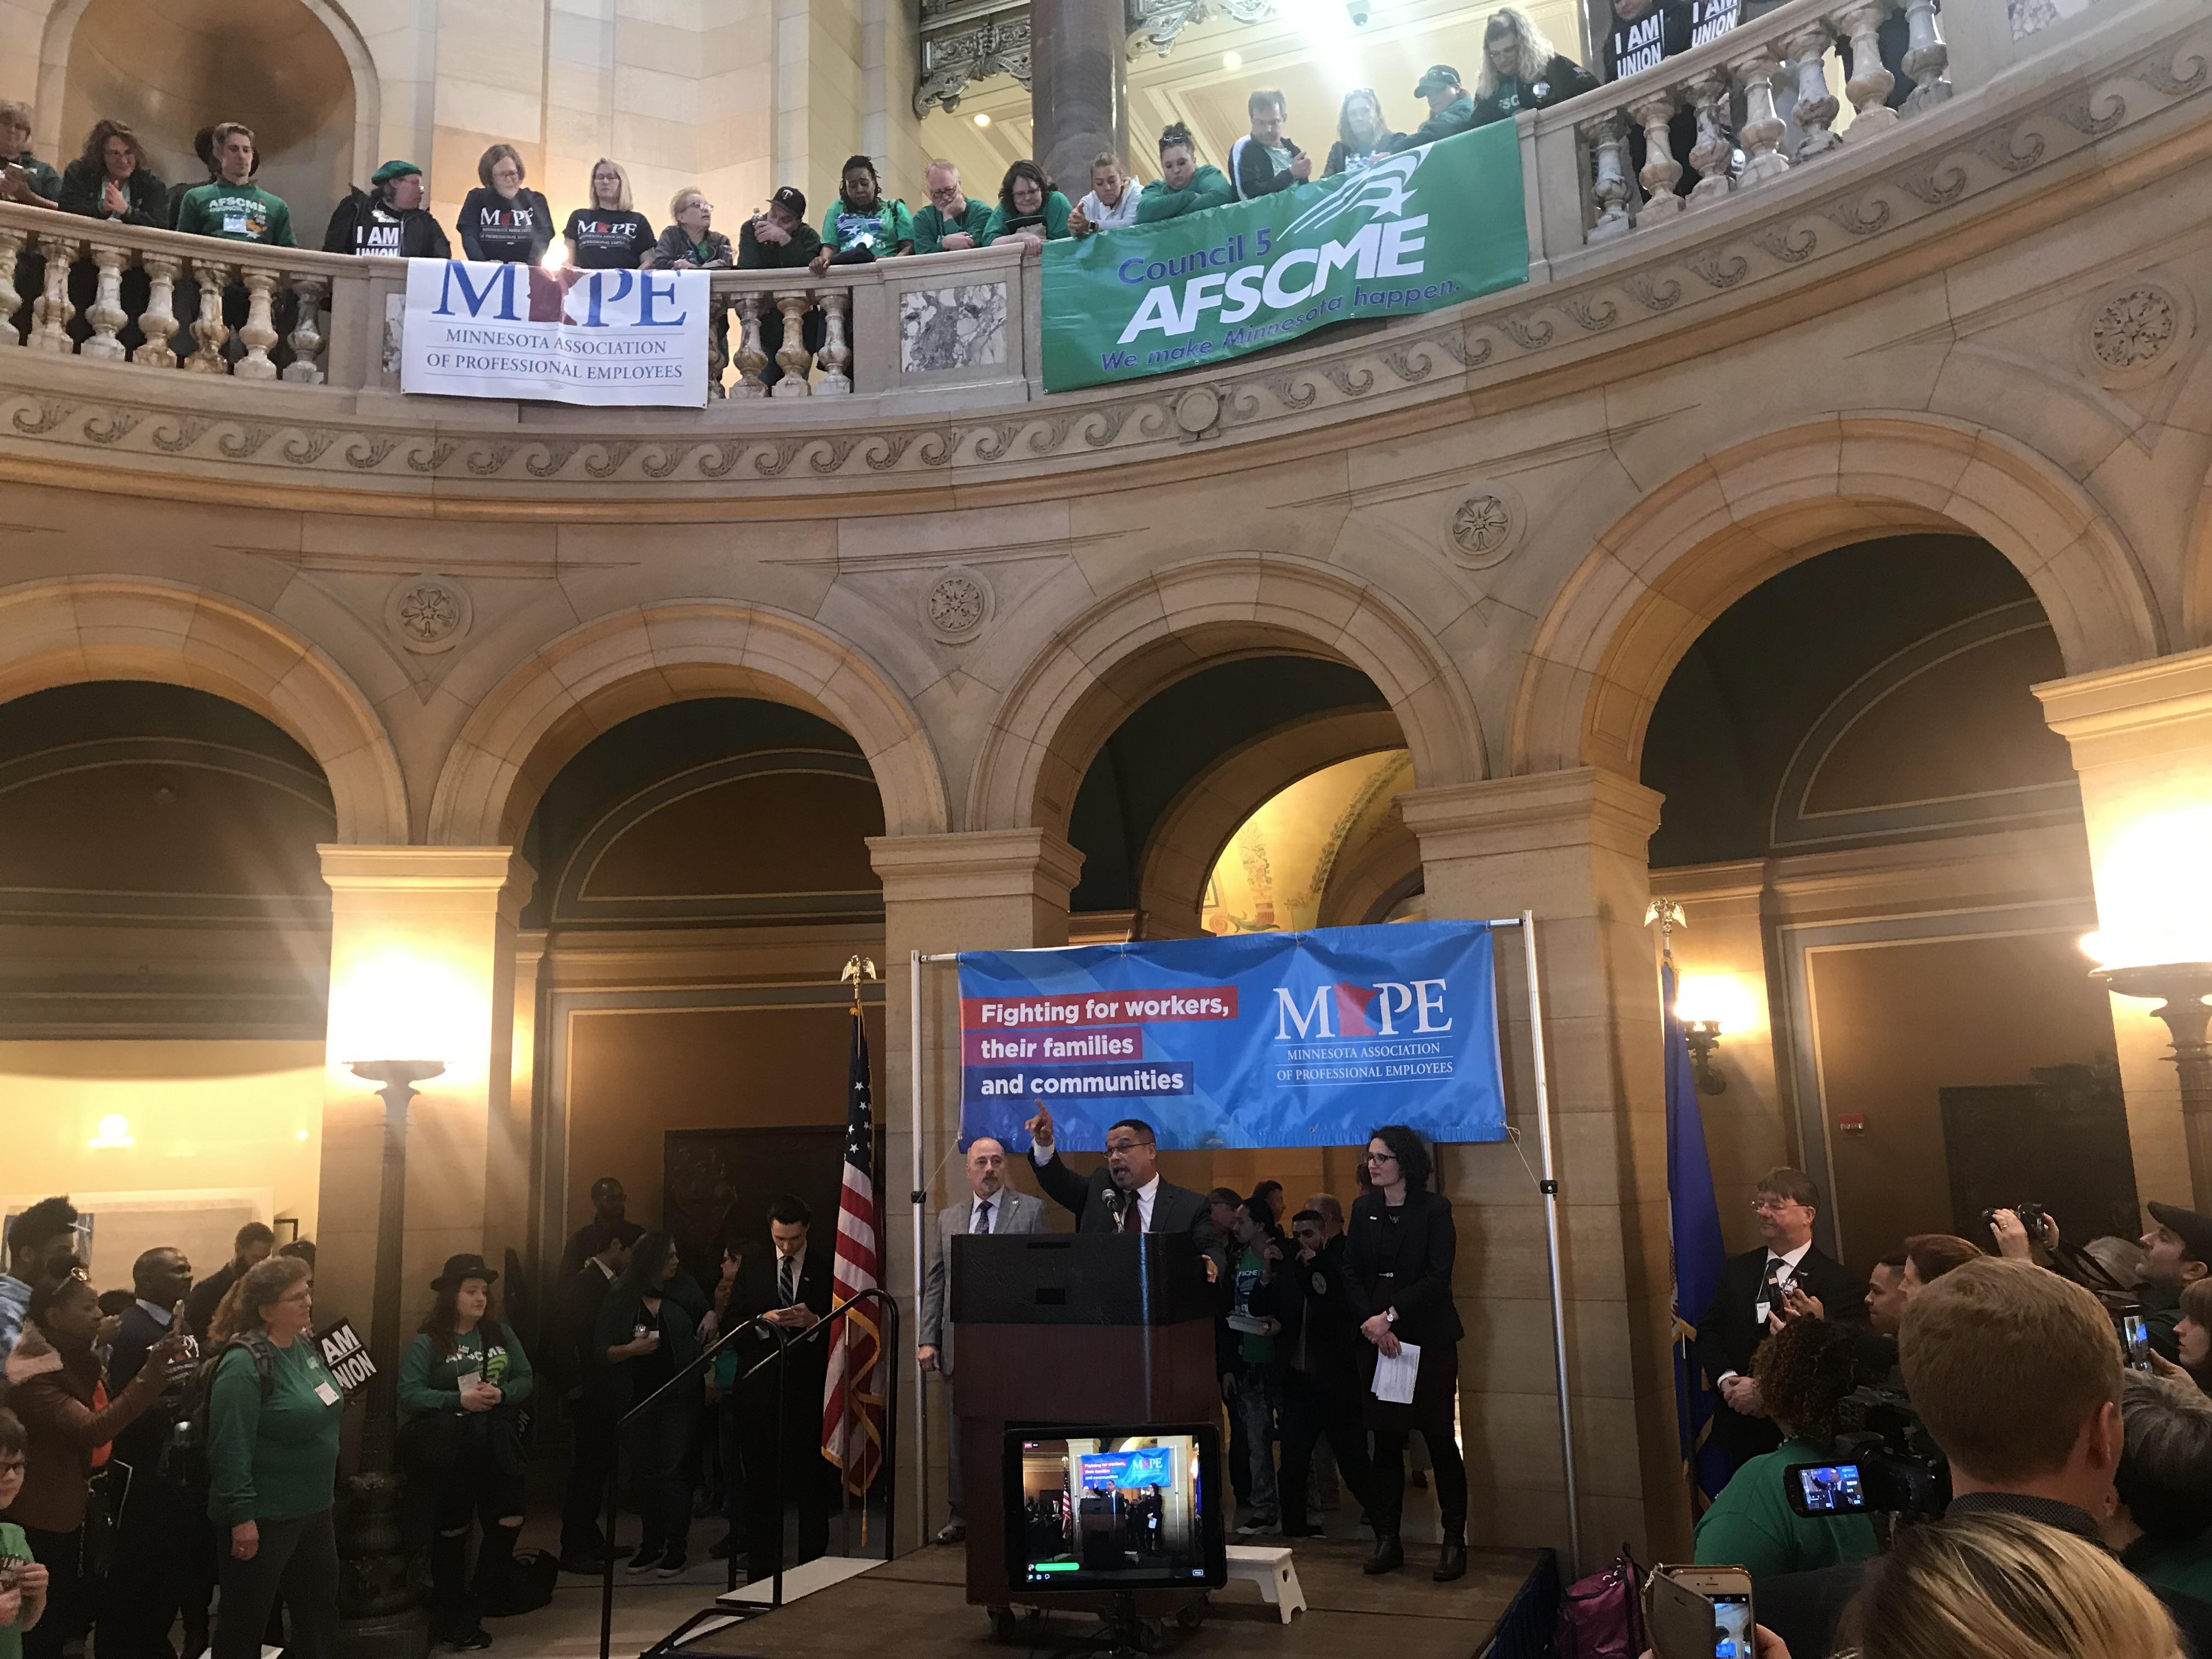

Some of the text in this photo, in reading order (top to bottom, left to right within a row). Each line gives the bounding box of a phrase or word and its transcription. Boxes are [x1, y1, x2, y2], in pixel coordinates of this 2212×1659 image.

[1693, 2, 1699, 24] I
[1615, 14, 1660, 54] I AM
[1692, 9, 1736, 48] UNION
[1617, 42, 1662, 80] UNION
[209, 196, 267, 213] AFSCME
[357, 226, 399, 245] I AM
[1118, 227, 1272, 284] Council 5
[1116, 213, 1429, 344] AFSCME
[1101, 279, 1461, 371] We make Minnesota happen.
[446, 329, 666, 354] MINNESOTA ASSOCIATION
[427, 353, 682, 380] OF PROFESSIONAL EMPLOYEES
[981, 995, 1229, 1026] Fighting for workers,
[981, 1035, 1133, 1059] their families
[1288, 1042, 1440, 1060] MINNESOTA ASSOCIATION
[981, 1070, 1184, 1095] and communities
[1277, 1062, 1453, 1081] OF PROFESSIONAL EMPLOYEES
[321, 1324, 361, 1365] AM
[332, 1350, 377, 1389] NION
